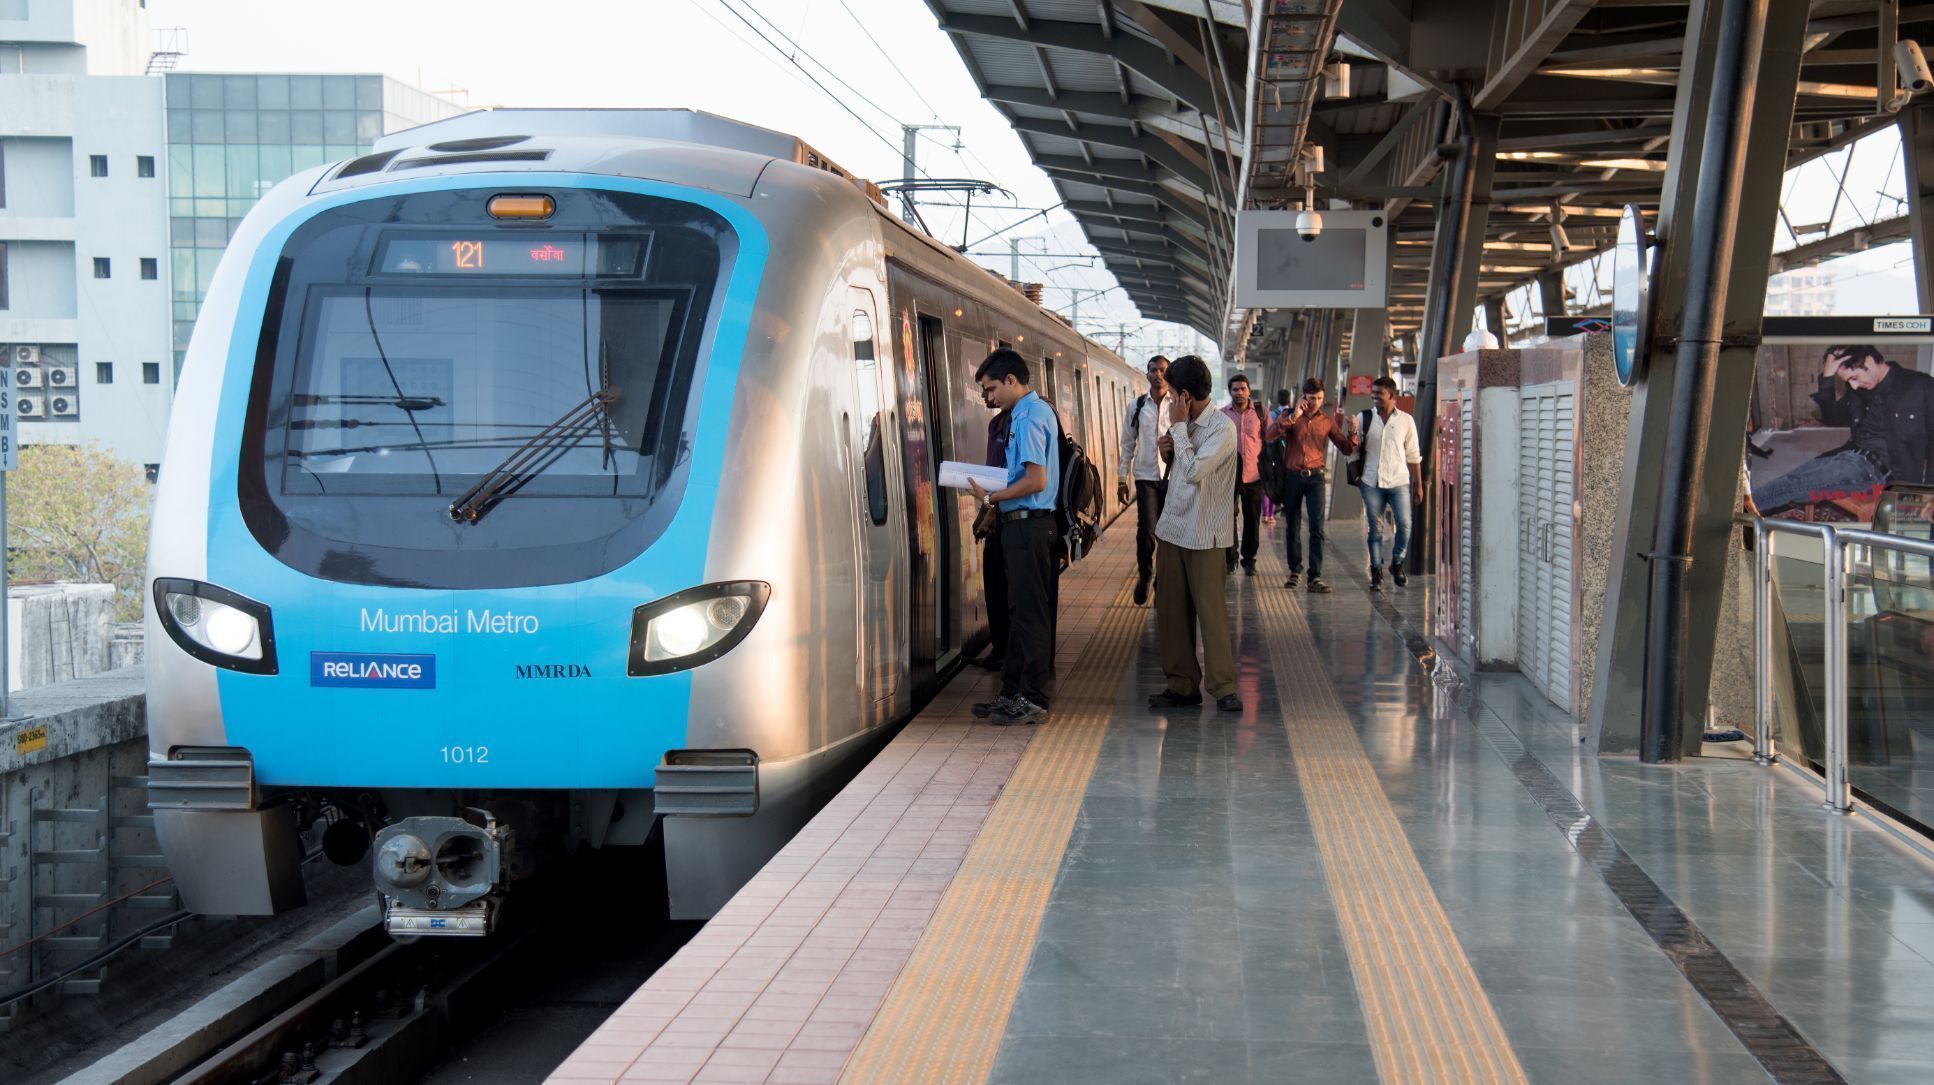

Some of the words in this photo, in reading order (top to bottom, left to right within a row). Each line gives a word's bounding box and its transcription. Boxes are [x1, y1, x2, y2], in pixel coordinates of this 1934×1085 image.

[452, 241, 482, 268] 121
[1876, 321, 1904, 329] TIMES
[360, 608, 458, 634] Mumbai
[467, 609, 539, 635] Metro
[515, 664, 592, 679] MMRDA
[440, 746, 489, 763] 1012
